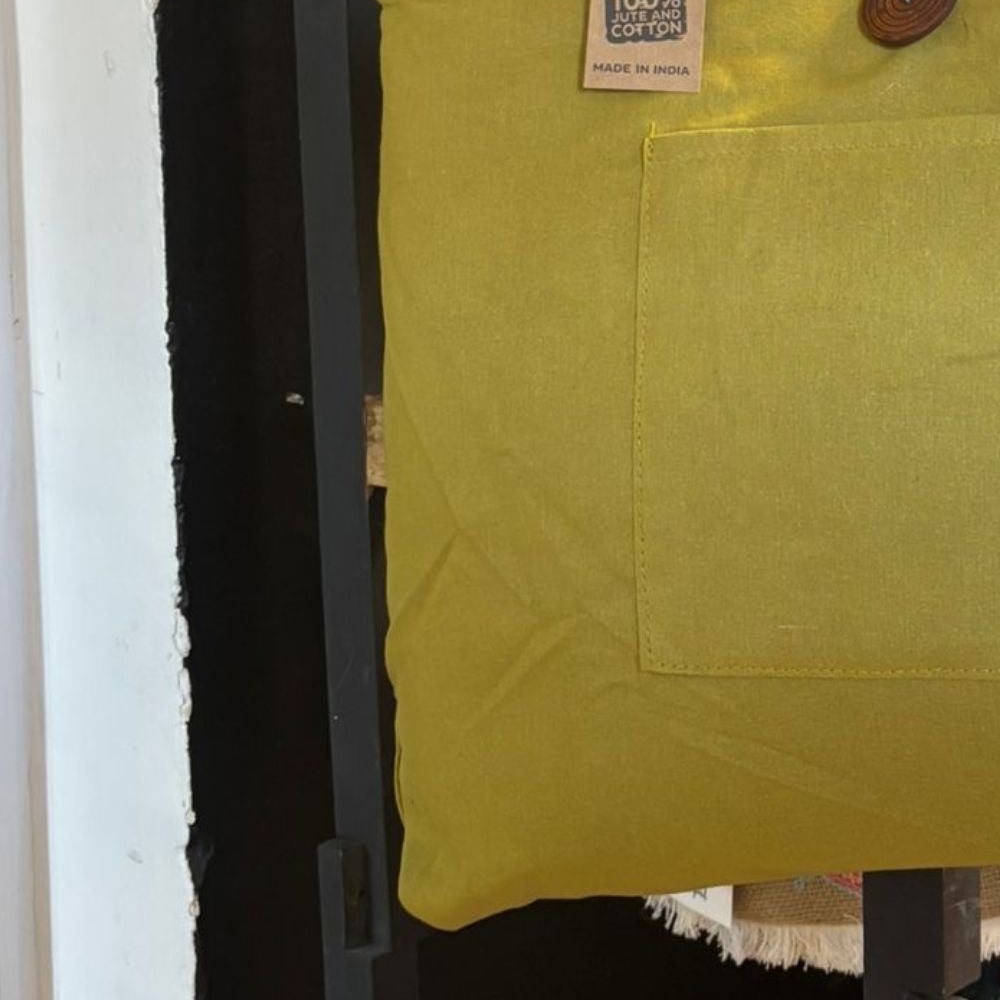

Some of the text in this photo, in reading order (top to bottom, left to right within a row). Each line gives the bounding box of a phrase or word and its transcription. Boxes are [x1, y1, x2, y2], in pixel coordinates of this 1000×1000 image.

[611, 8, 681, 23] JUTE AND
[610, 21, 682, 38] COTTON
[593, 62, 690, 76] MADE IN INDIA
